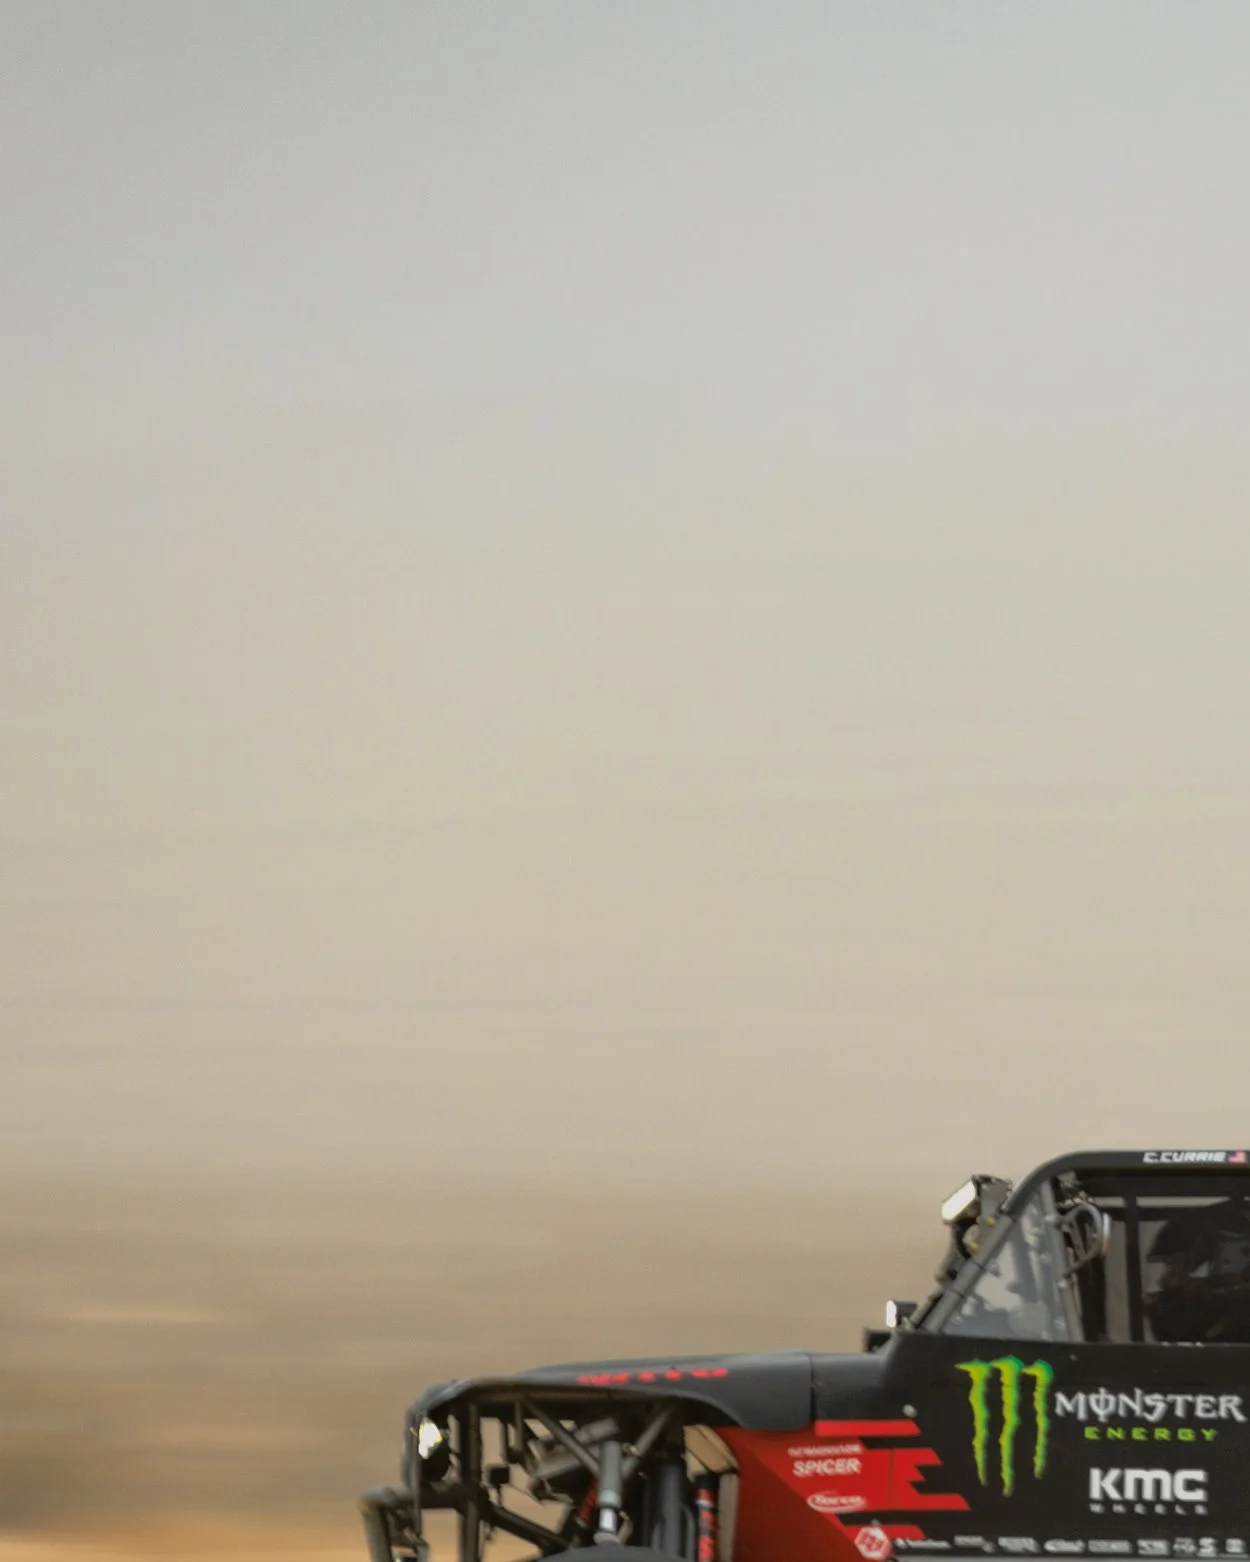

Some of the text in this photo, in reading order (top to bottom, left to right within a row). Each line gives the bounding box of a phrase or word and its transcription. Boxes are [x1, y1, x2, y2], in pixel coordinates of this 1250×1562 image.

[1055, 1387, 1248, 1423] MONSTER
[1084, 1426, 1218, 1441] ENERGY
[793, 1457, 862, 1478] SPICER
[1089, 1467, 1208, 1502] KMC
